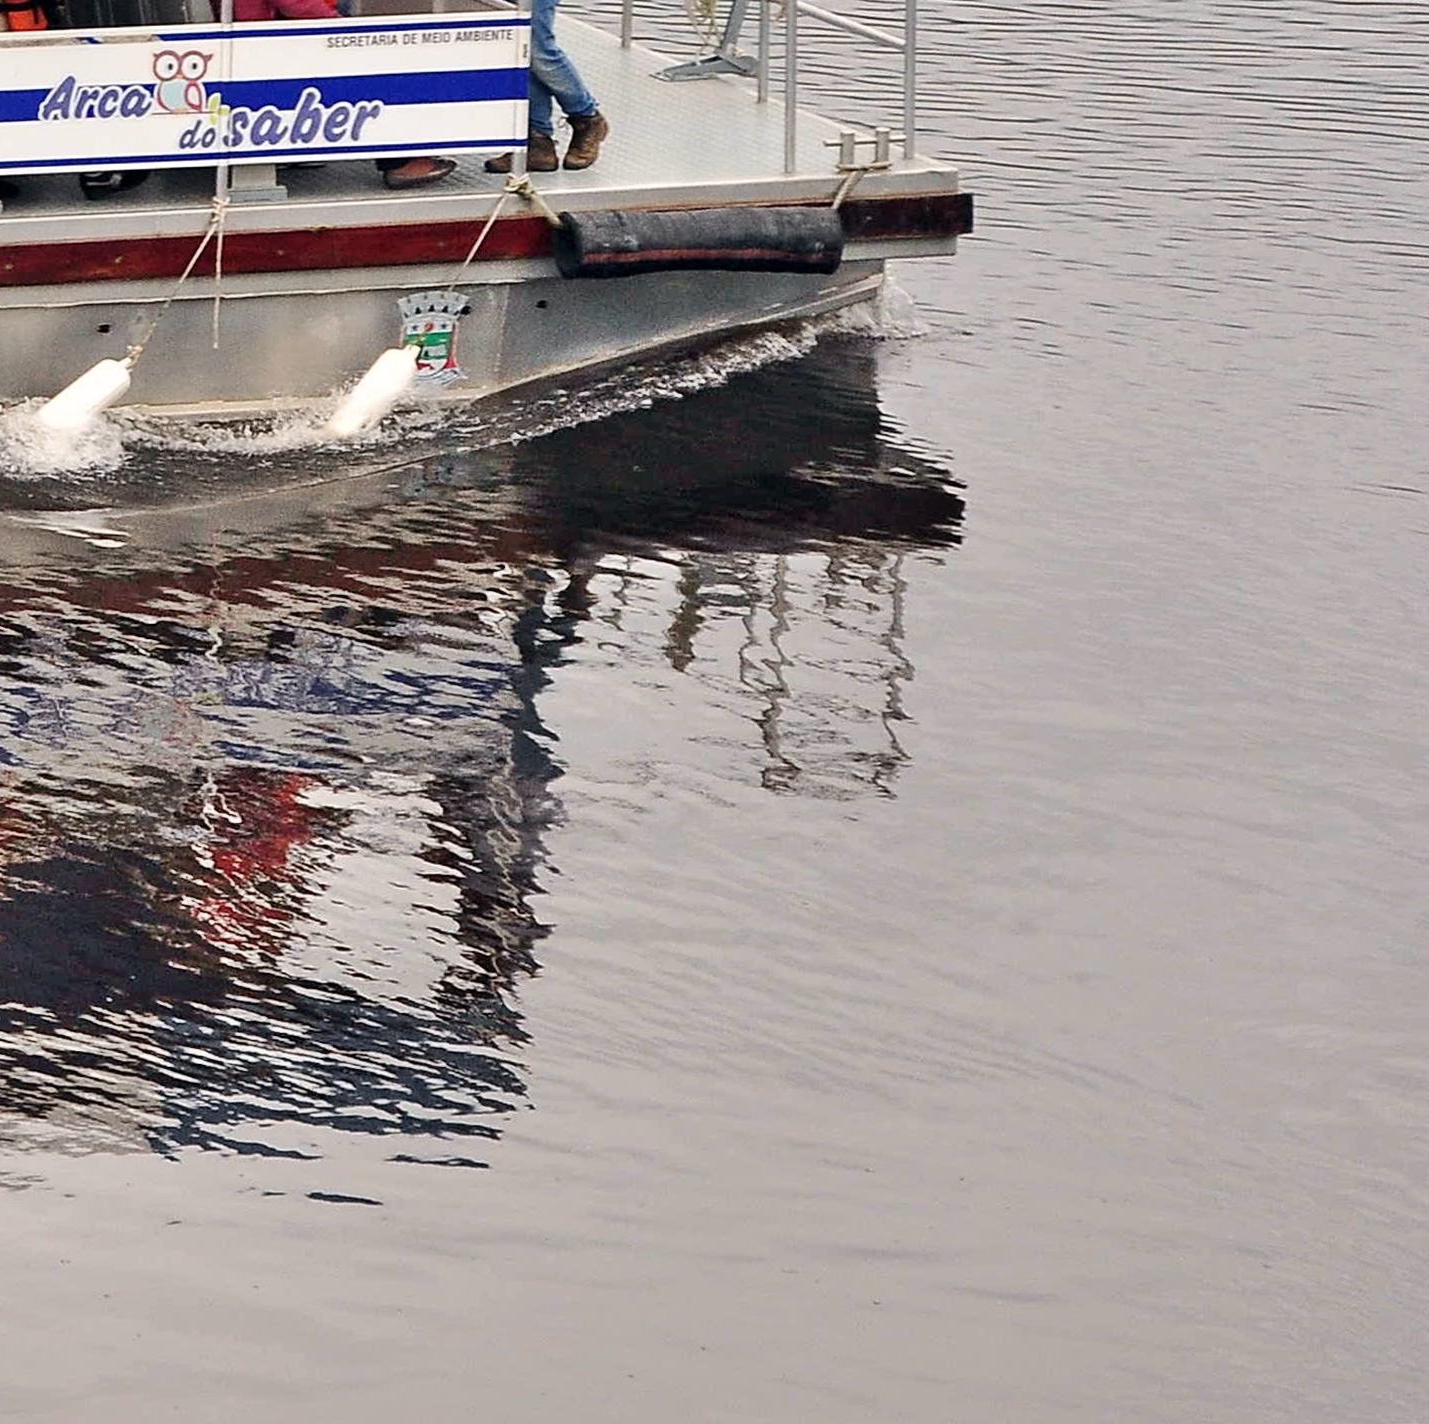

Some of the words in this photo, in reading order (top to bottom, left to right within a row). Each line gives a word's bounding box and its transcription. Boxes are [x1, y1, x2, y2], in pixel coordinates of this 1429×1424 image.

[327, 35, 399, 48] SECRETARIA
[403, 33, 418, 45] DE
[422, 32, 451, 44] MEIO
[455, 29, 514, 42] AMBIENTE
[40, 74, 152, 120] Arca
[179, 120, 216, 149] do
[222, 90, 382, 148] saber
